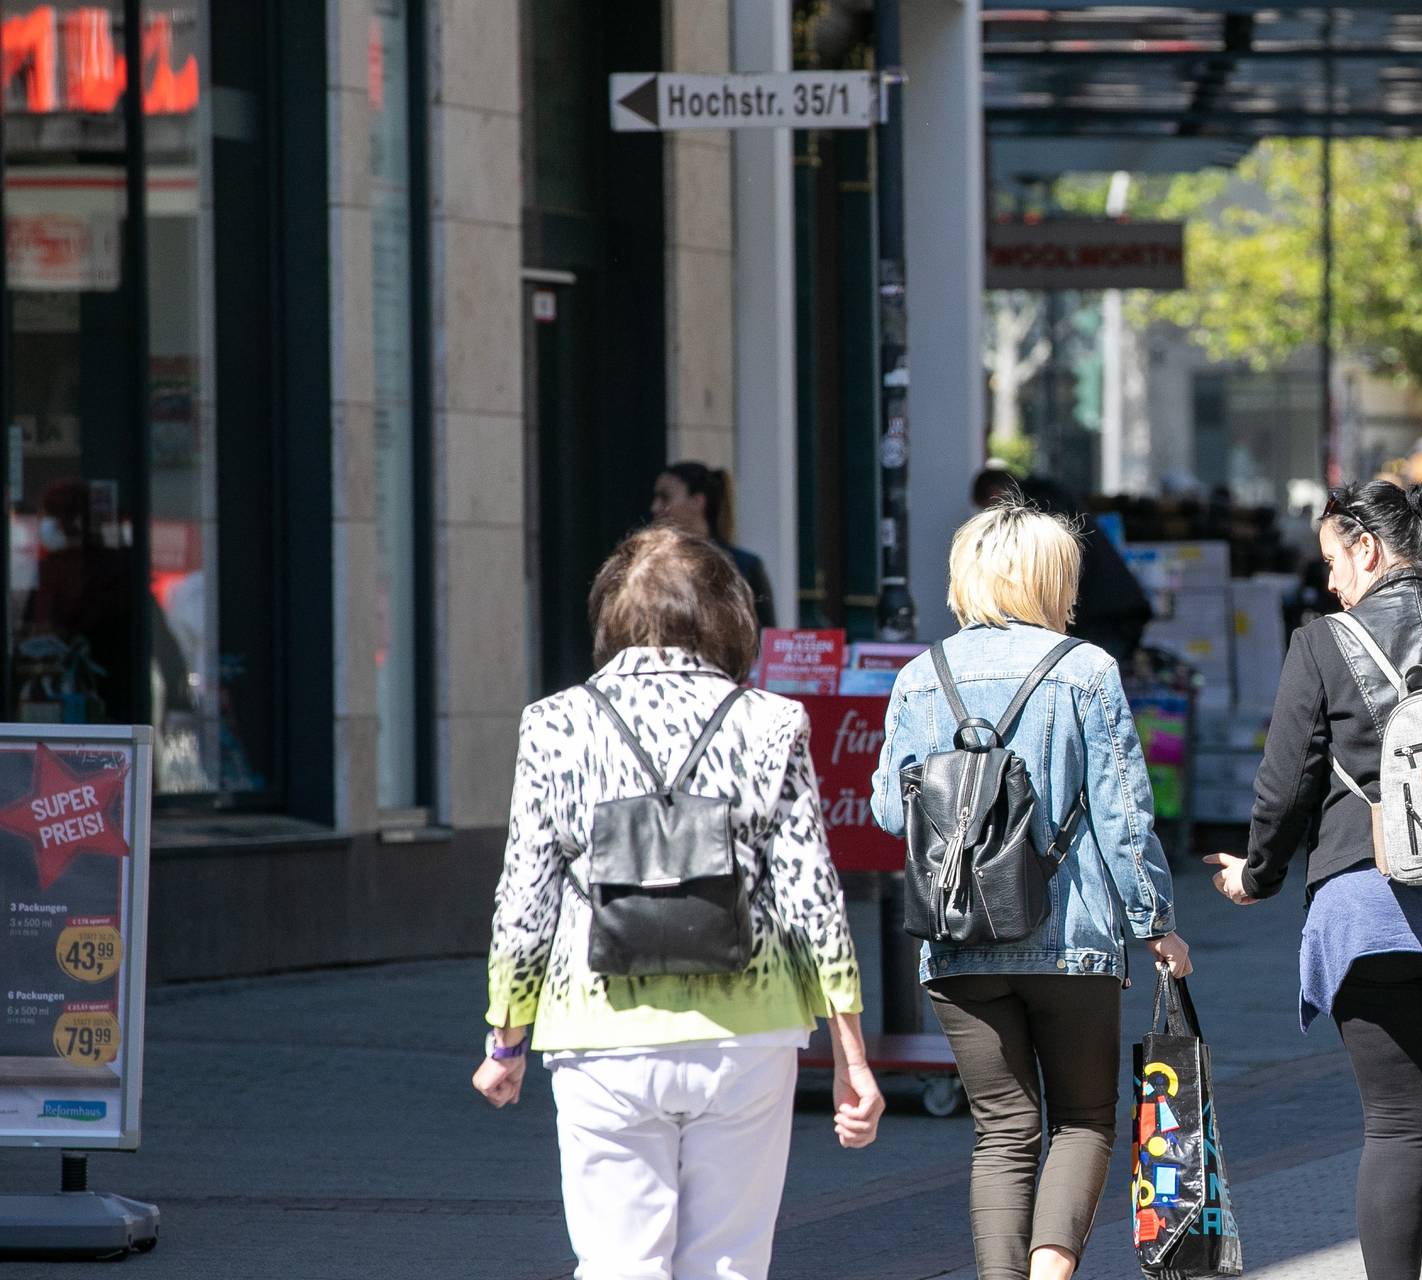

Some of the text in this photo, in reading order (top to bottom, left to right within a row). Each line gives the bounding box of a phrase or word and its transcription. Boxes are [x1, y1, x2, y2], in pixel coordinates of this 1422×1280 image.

[667, 83, 849, 116] Hochstr. 35/1
[831, 709, 884, 765] für
[31, 785, 98, 821] SUPER
[39, 811, 104, 848] PREIS!
[9, 918, 16, 927] 3
[24, 918, 39, 927] 500
[10, 902, 67, 914] 3 Packungen
[66, 941, 114, 975] 43,99
[8, 991, 64, 1002] 6 Packungen
[8, 1006, 13, 1015] 6
[21, 1006, 37, 1015] 500
[64, 1027, 111, 1060] 79,99
[45, 1104, 101, 1117] Reformhaus
